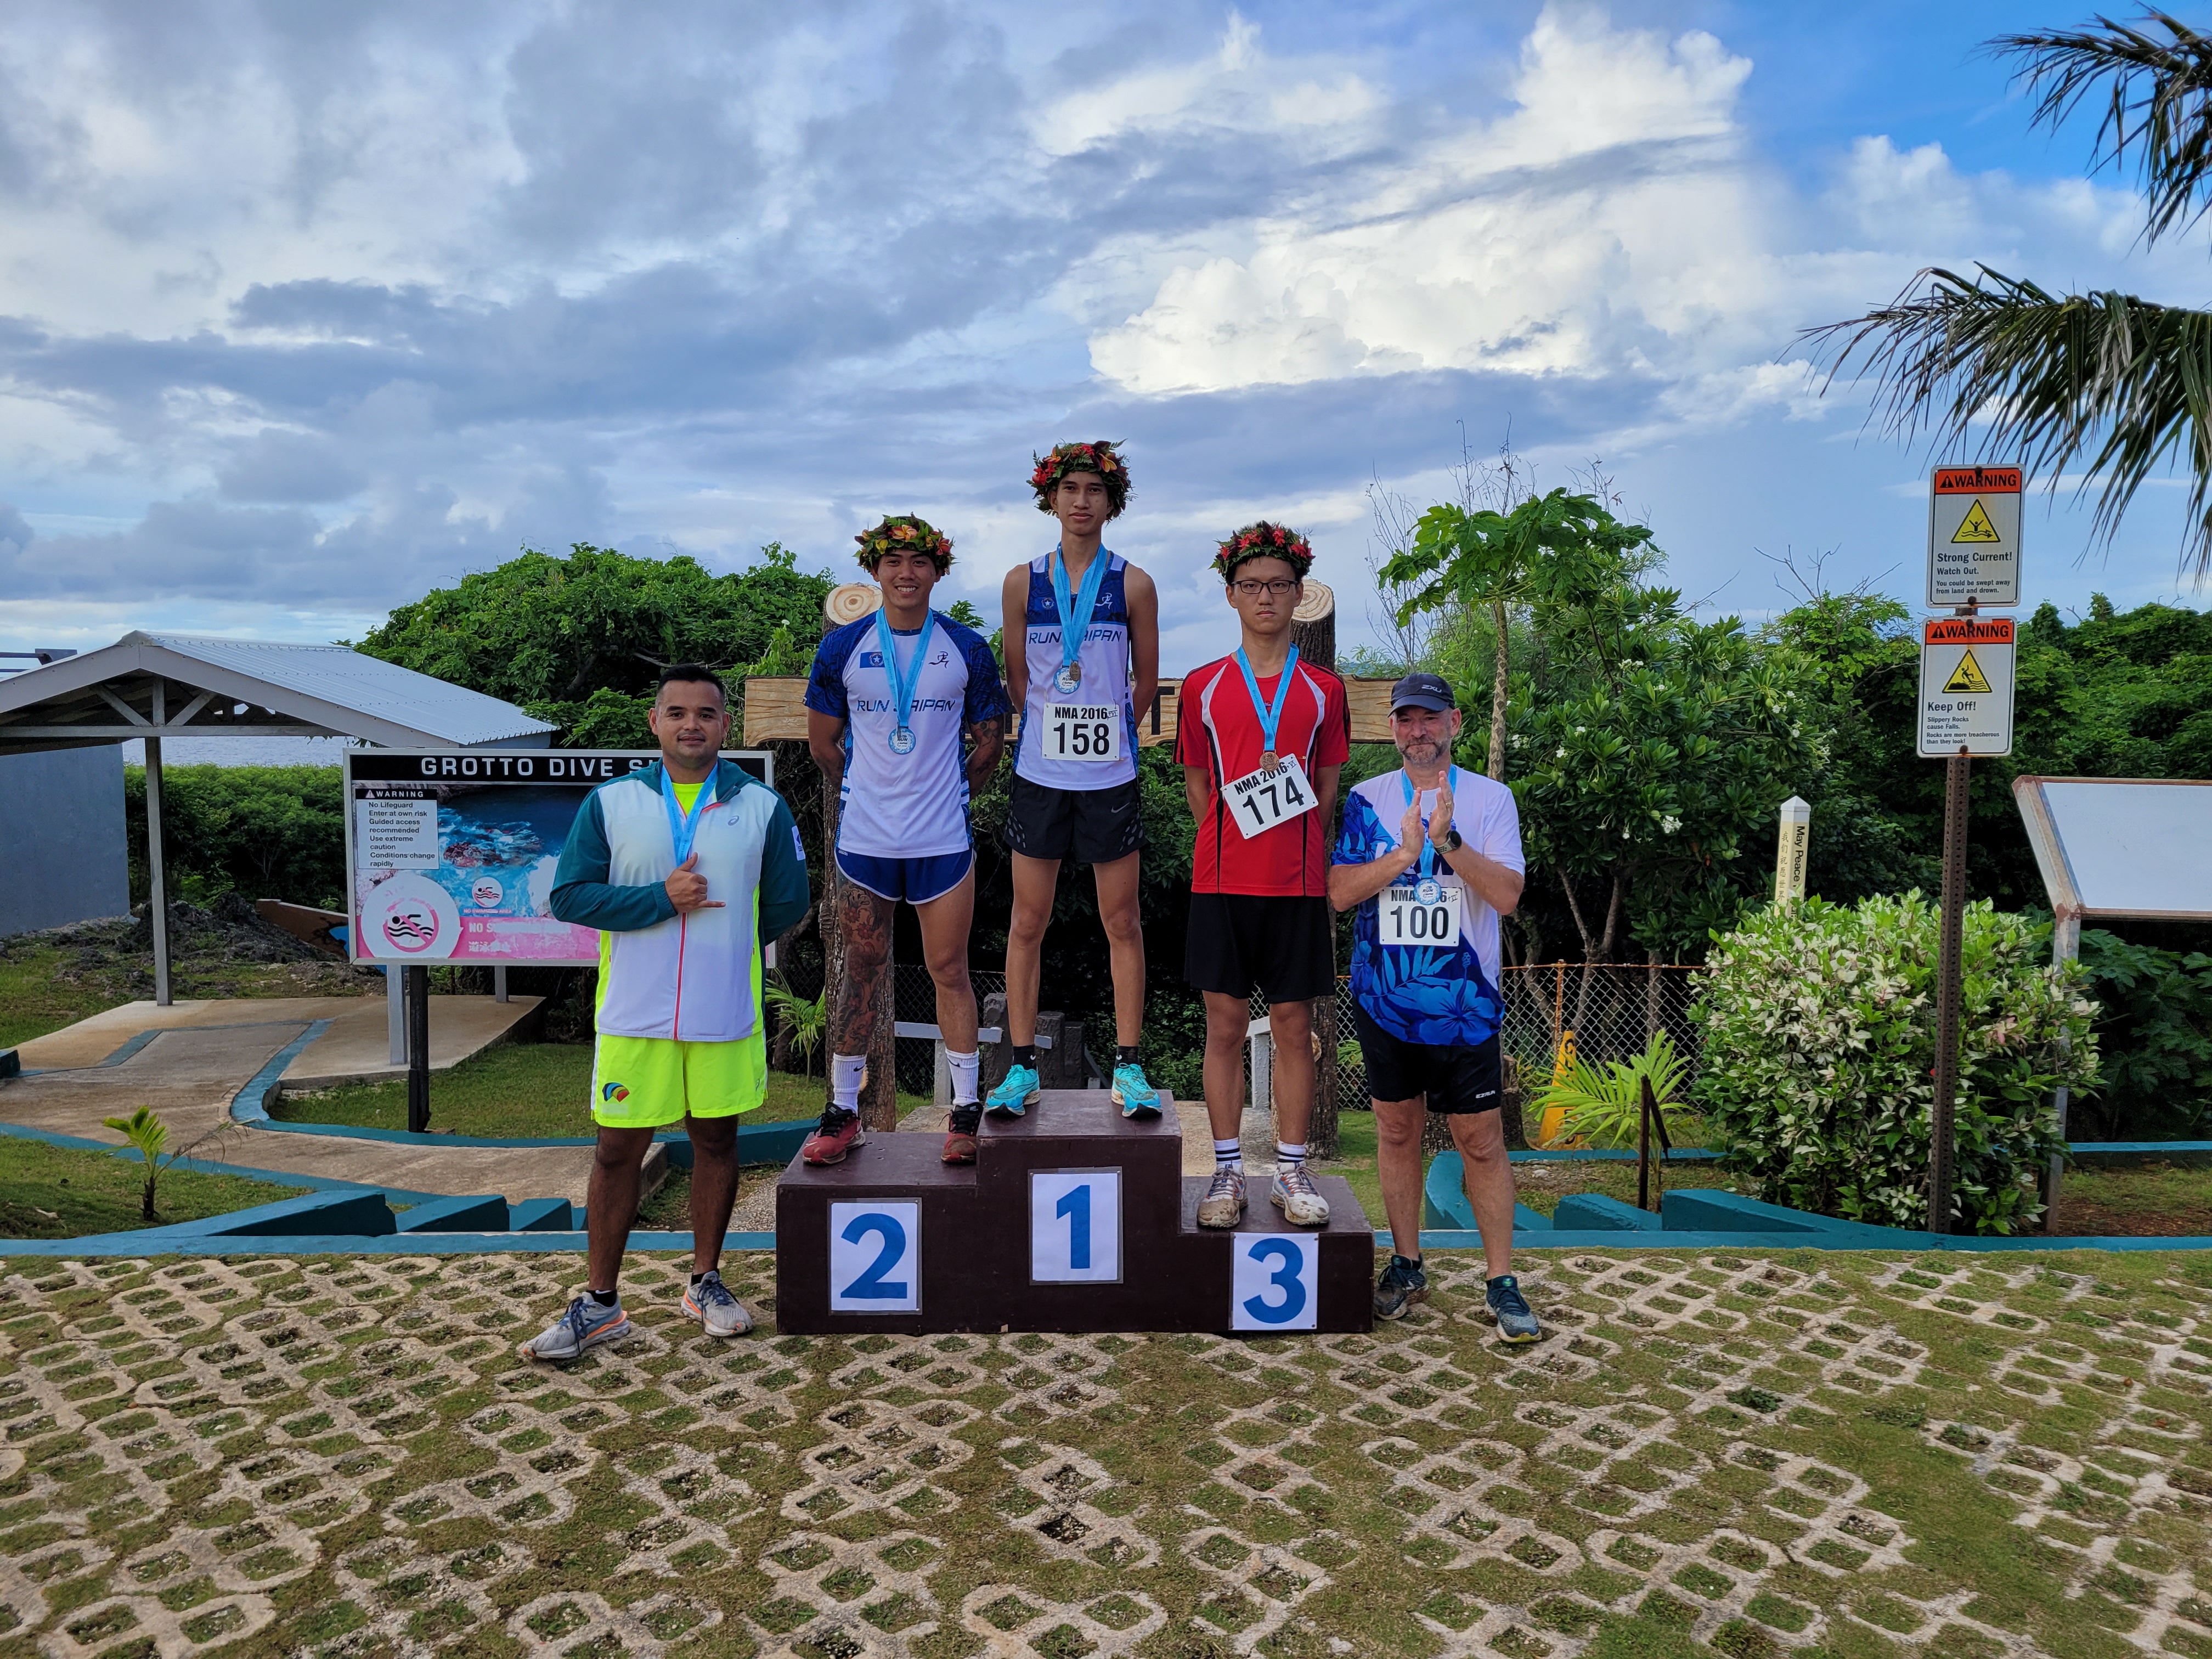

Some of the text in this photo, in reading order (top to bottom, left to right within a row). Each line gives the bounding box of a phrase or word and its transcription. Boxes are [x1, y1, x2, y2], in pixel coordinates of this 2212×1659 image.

[1955, 475, 2017, 487] WARNING
[1937, 552, 2012, 563] Strong Current!
[1029, 631, 1061, 645] RUN
[1946, 625, 2009, 637] WARNING
[857, 700, 889, 712] RUN
[1055, 707, 1108, 720] NMA 2016
[1928, 701, 1976, 713] Keep Off!
[1053, 723, 1110, 755] 158
[421, 758, 533, 775] GROTTO
[550, 758, 613, 776] DIVE
[1234, 762, 1289, 795] NMA 2016
[1243, 775, 1304, 826] 174
[1795, 826, 1805, 847] May
[1794, 850, 1803, 882] Peace
[1391, 889, 1415, 902] NMA
[469, 923, 483, 932] NO
[1390, 905, 1449, 940] 100
[1056, 1184, 1091, 1269] 1
[840, 1212, 908, 1300] 2
[1242, 1237, 1306, 1324] 3
